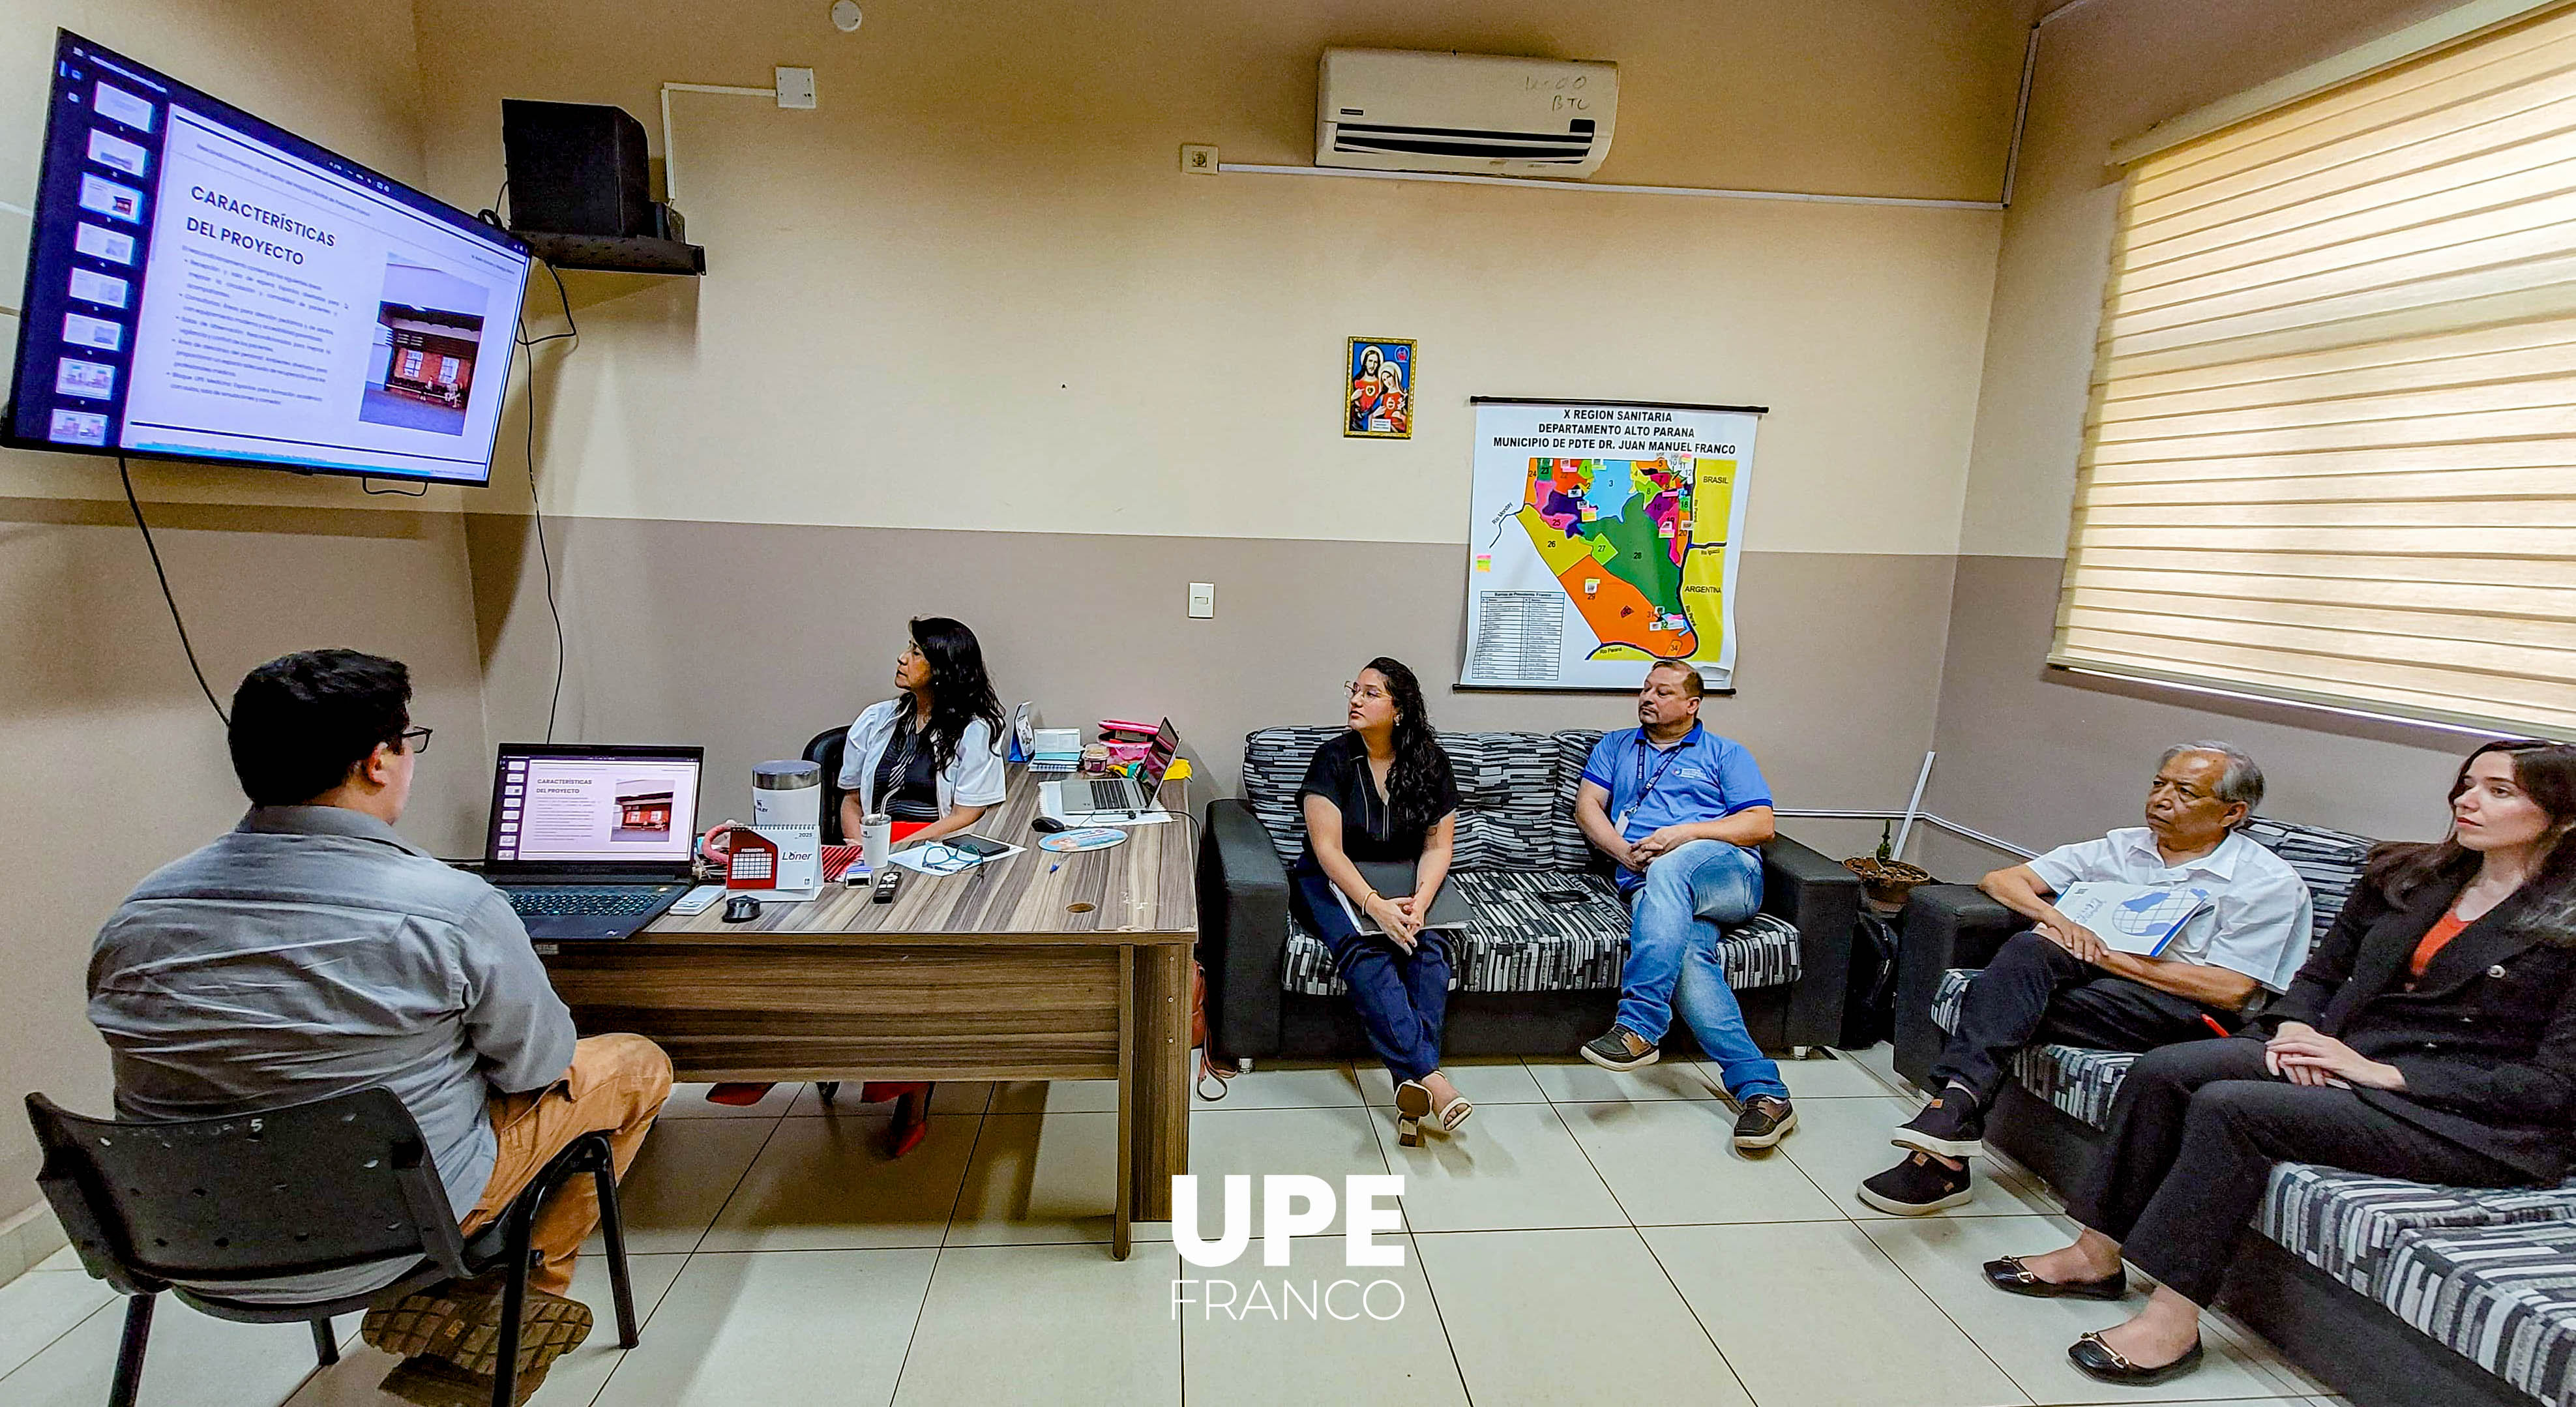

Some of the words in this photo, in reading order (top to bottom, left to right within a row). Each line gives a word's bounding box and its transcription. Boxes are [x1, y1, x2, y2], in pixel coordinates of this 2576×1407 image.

[191, 186, 335, 246] CARACTERÍSTICAS
[186, 217, 216, 239] DEL
[220, 228, 304, 265] PROYECTO
[1563, 409, 1571, 419] X
[1573, 409, 1614, 420] REGION
[1617, 411, 1672, 422] SANITARIA
[1539, 423, 1621, 435] DEPARTAMENTO
[1624, 426, 1650, 436] ALTO
[1653, 427, 1695, 437] PARANA
[1493, 437, 1549, 447] MUNICIPIO
[1552, 438, 1565, 447] DE
[1568, 439, 1595, 449] PDTE
[1599, 439, 1615, 449] DR.
[1618, 440, 1646, 450] JUAN
[1648, 441, 1692, 452] MANUEL
[1695, 443, 1736, 454] FRANCO
